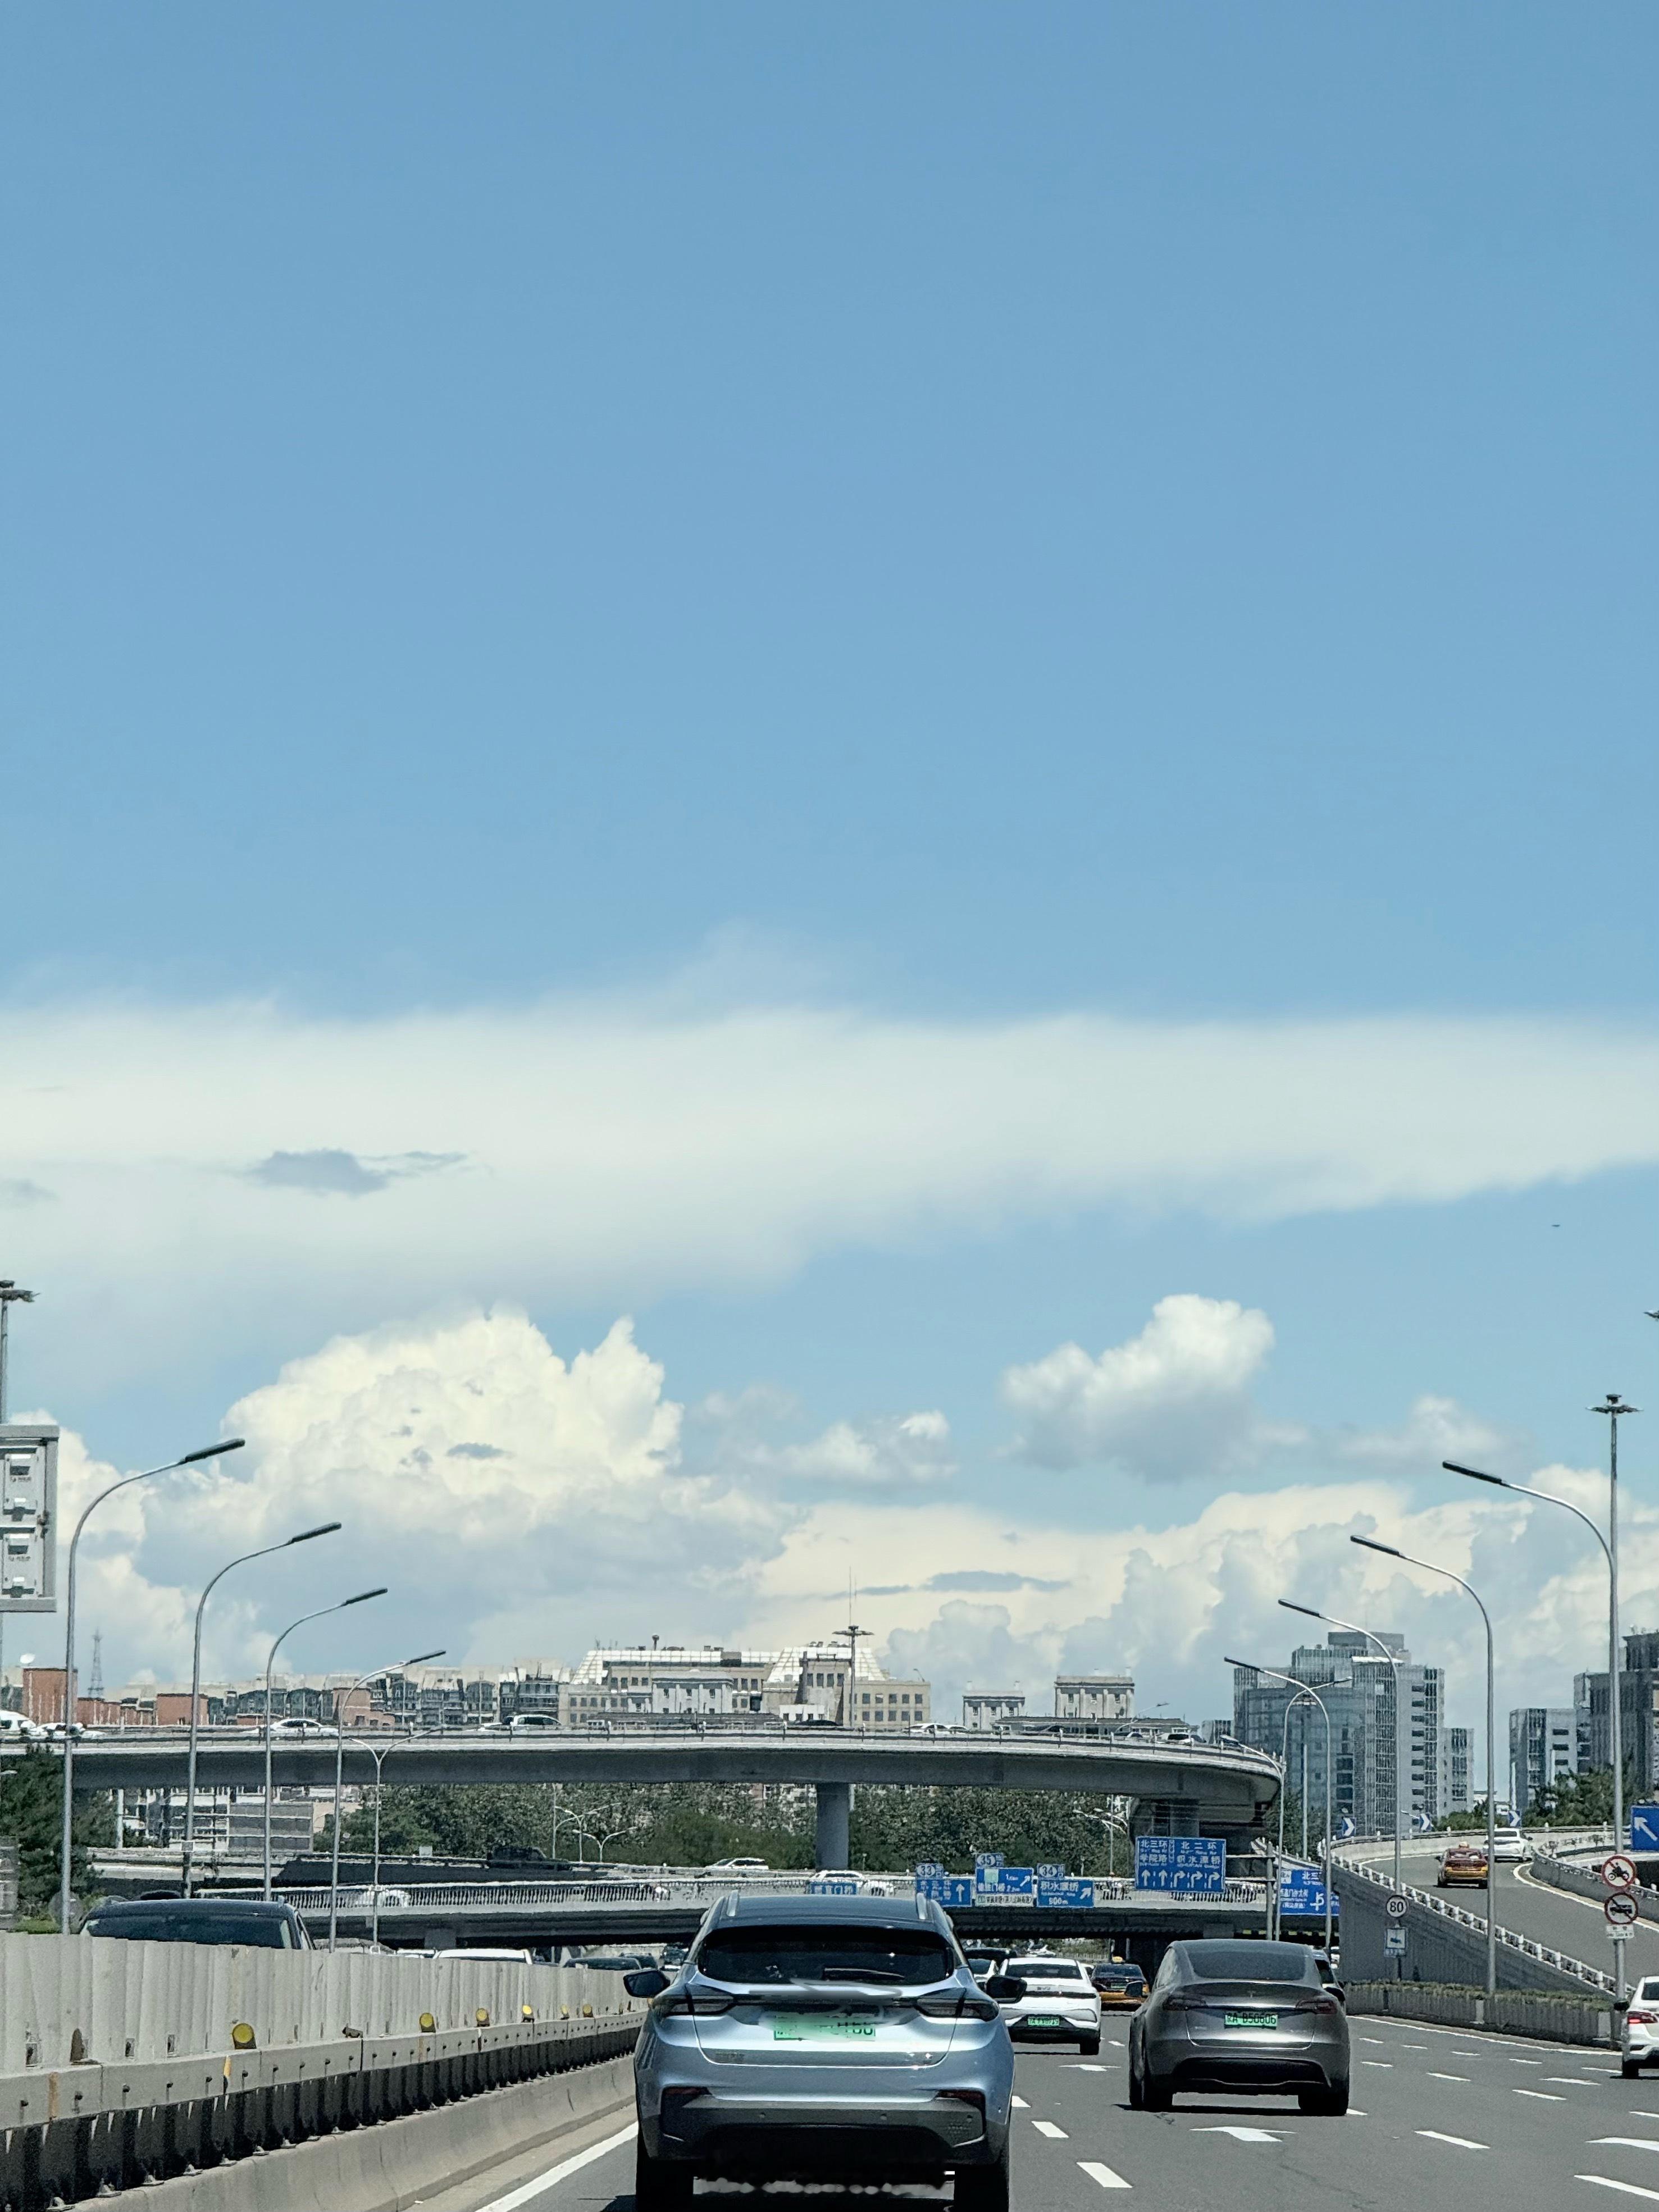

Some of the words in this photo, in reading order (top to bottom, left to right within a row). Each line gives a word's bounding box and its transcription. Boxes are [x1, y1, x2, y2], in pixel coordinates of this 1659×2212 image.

[1141, 1839, 1168, 1849] 北三环
[1181, 1841, 1217, 1850] 北二环
[981, 1855, 991, 1865] 35
[1140, 1854, 1168, 1863] 学院路
[920, 1866, 932, 1876] 33
[1042, 1866, 1054, 1876] 34
[1302, 1871, 1321, 1880] 北三
[1390, 1901, 1403, 1912] 80
